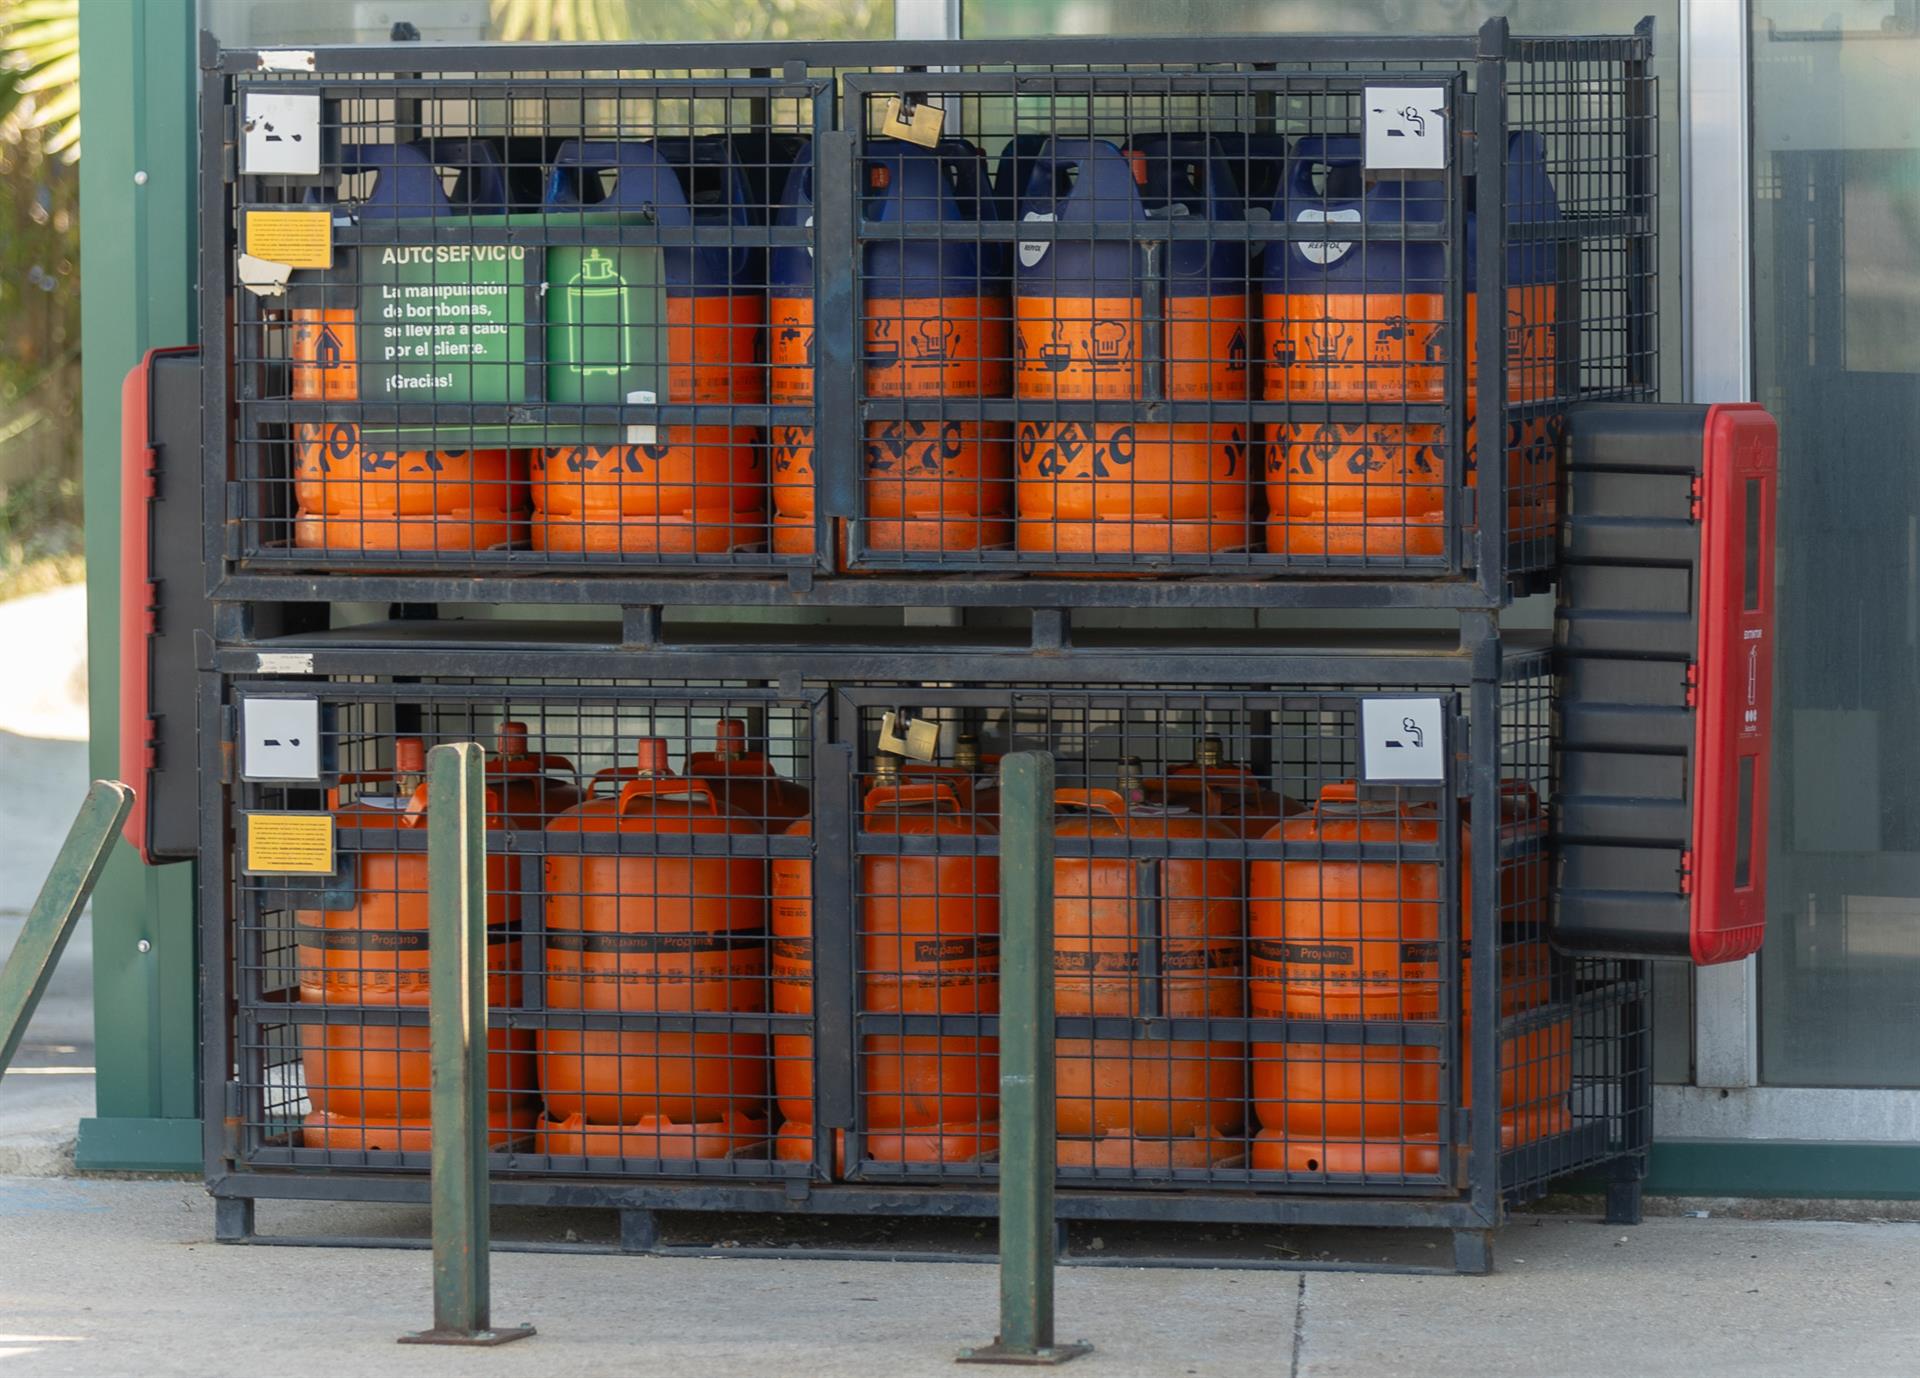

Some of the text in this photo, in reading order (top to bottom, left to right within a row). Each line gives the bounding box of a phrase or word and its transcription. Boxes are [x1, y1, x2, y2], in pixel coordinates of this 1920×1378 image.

[382, 281, 508, 300] La manipulación
[383, 301, 492, 318] de bombonas,
[384, 325, 402, 338] se
[459, 324, 469, 336] a
[472, 320, 508, 335] cabo
[384, 345, 412, 361] por
[415, 341, 429, 356] el
[385, 372, 454, 393] ¡Gracias!
